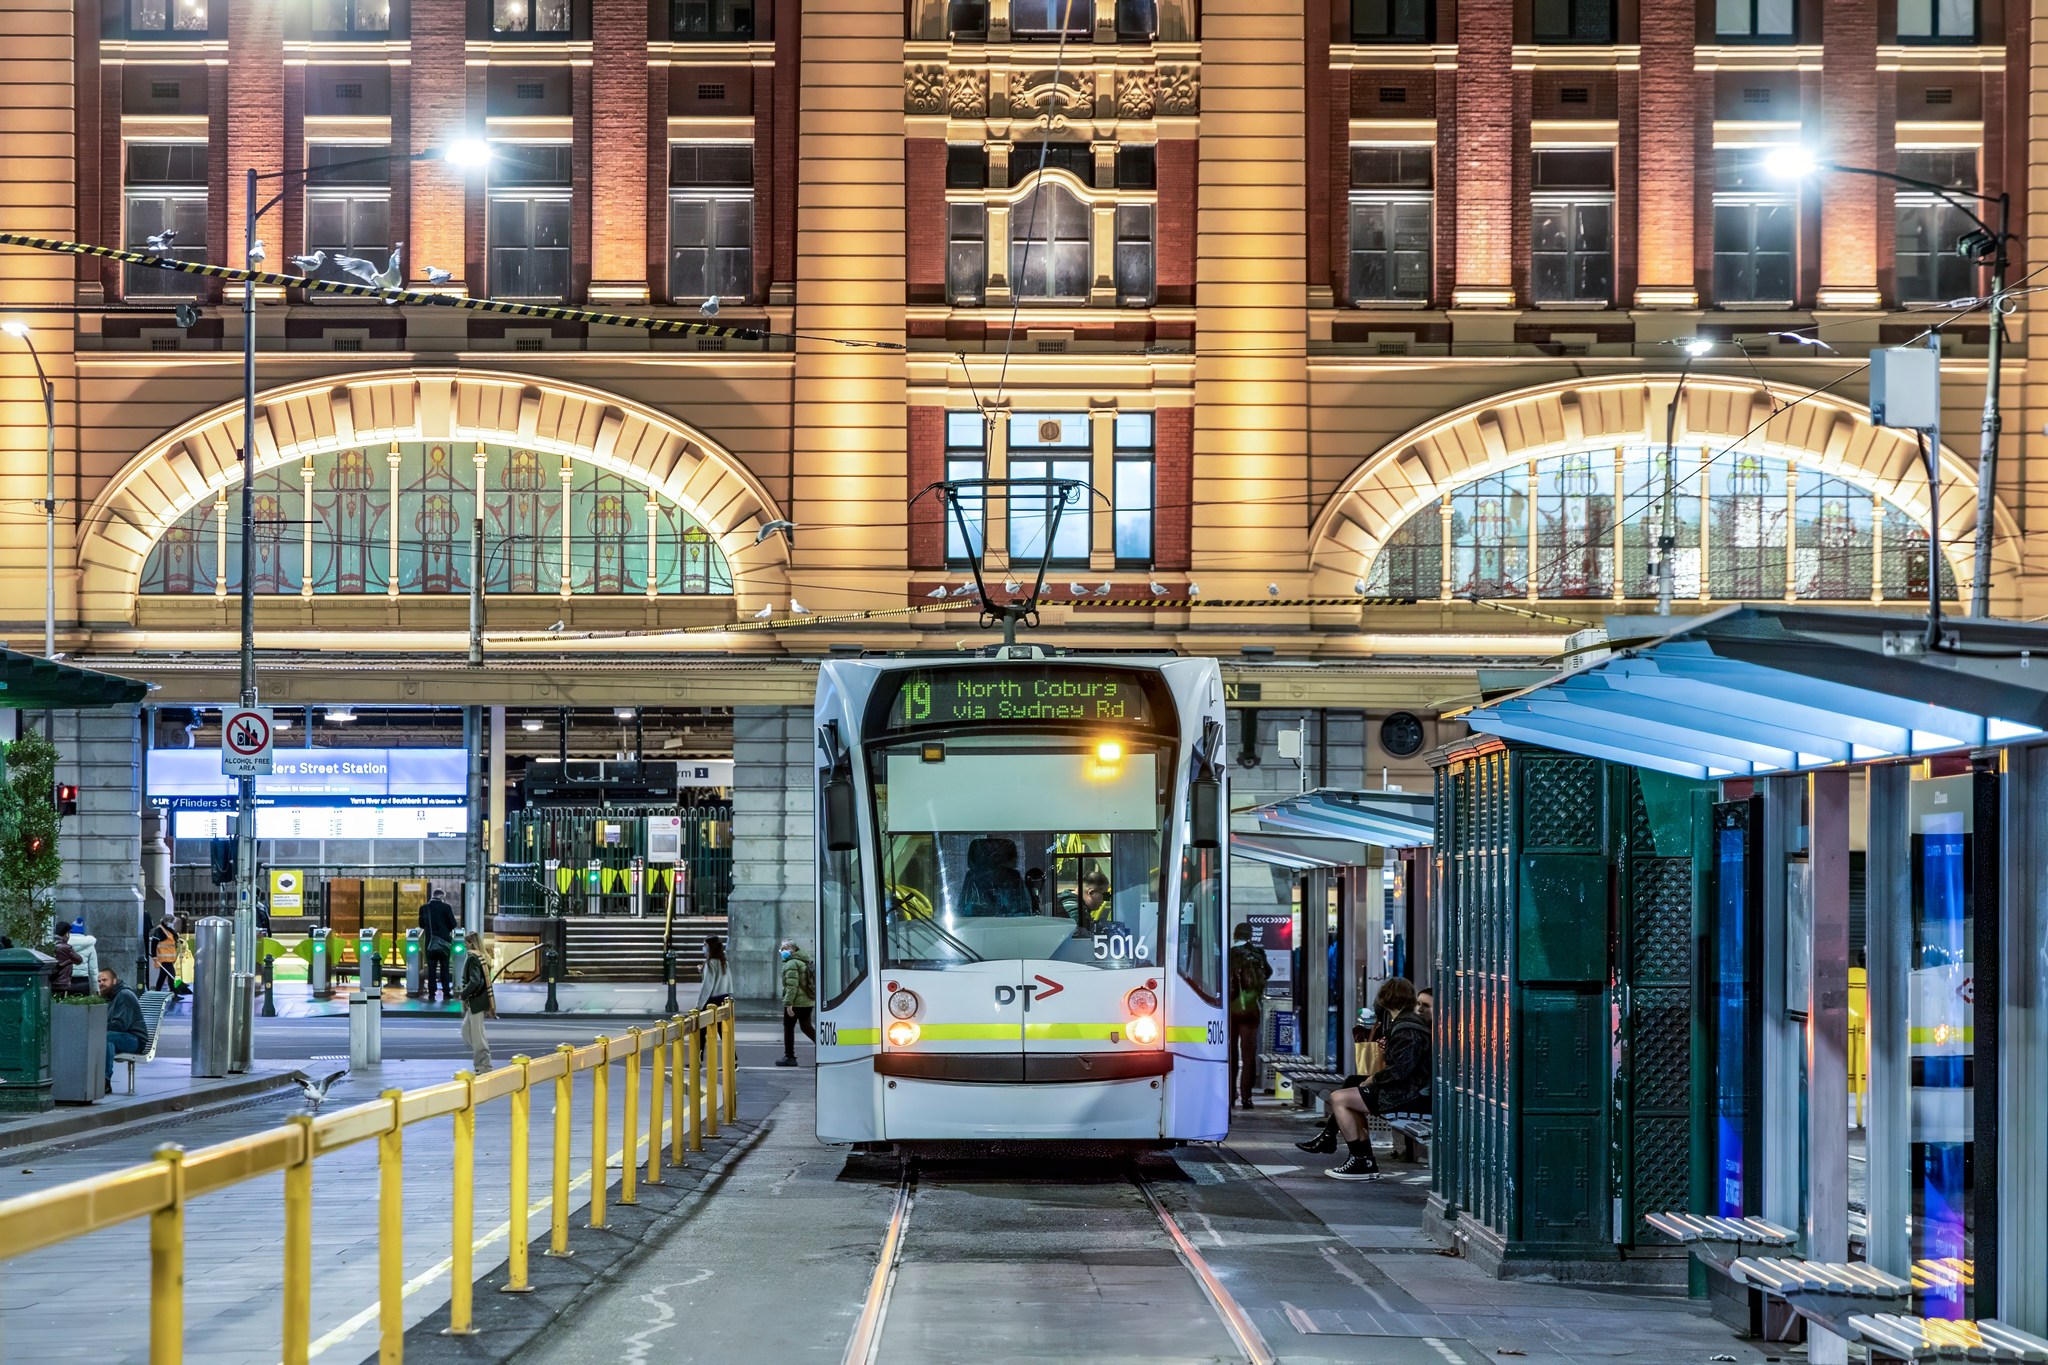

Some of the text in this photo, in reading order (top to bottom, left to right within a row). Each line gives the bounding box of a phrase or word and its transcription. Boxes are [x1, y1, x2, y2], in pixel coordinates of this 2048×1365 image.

[901, 680, 1118, 720] 19 North Coburg
[953, 700, 1125, 719] via Sydney Rd
[271, 762, 387, 774] ders Street Station
[180, 798, 218, 808] Flinders
[220, 798, 232, 808] St
[1093, 934, 1149, 960] 5016
[820, 1021, 837, 1046] 5016
[1207, 1020, 1224, 1045] 5016
